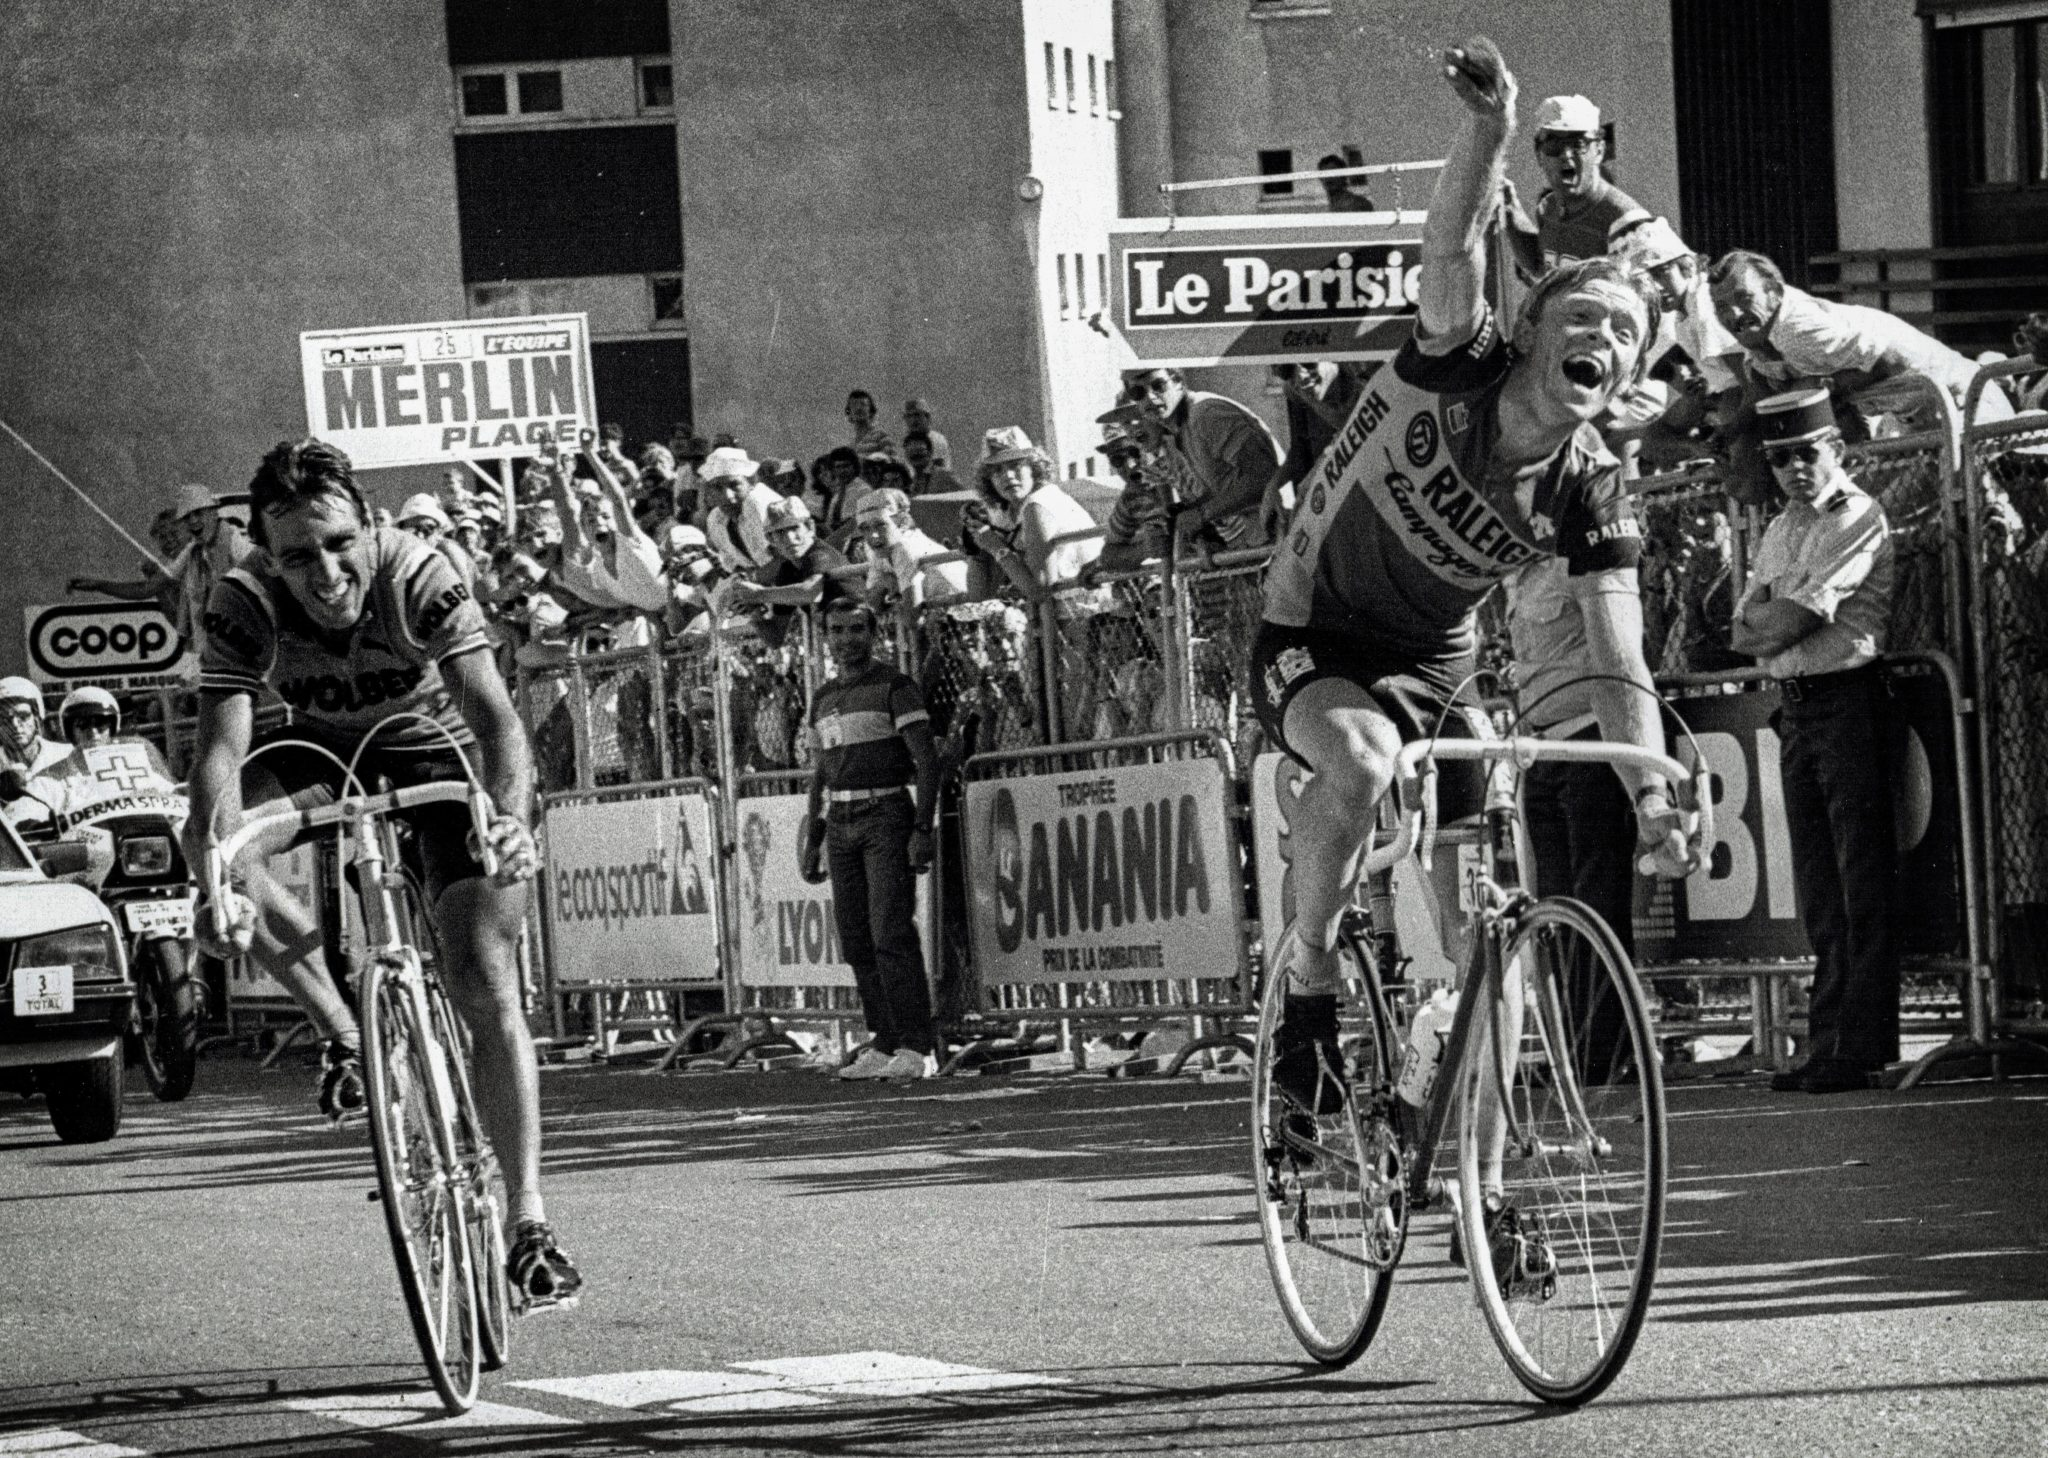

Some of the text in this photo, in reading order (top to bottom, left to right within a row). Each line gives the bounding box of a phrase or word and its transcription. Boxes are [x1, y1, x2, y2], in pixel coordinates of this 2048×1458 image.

[1134, 258, 1210, 316] Le
[434, 335, 457, 356] 25
[322, 354, 577, 431] MERLIN
[441, 418, 577, 451] PLAGE
[1324, 389, 1391, 490] RALEIGH
[50, 621, 167, 660] coop
[38, 973, 48, 997] 3
[25, 997, 62, 1012] TOTAL
